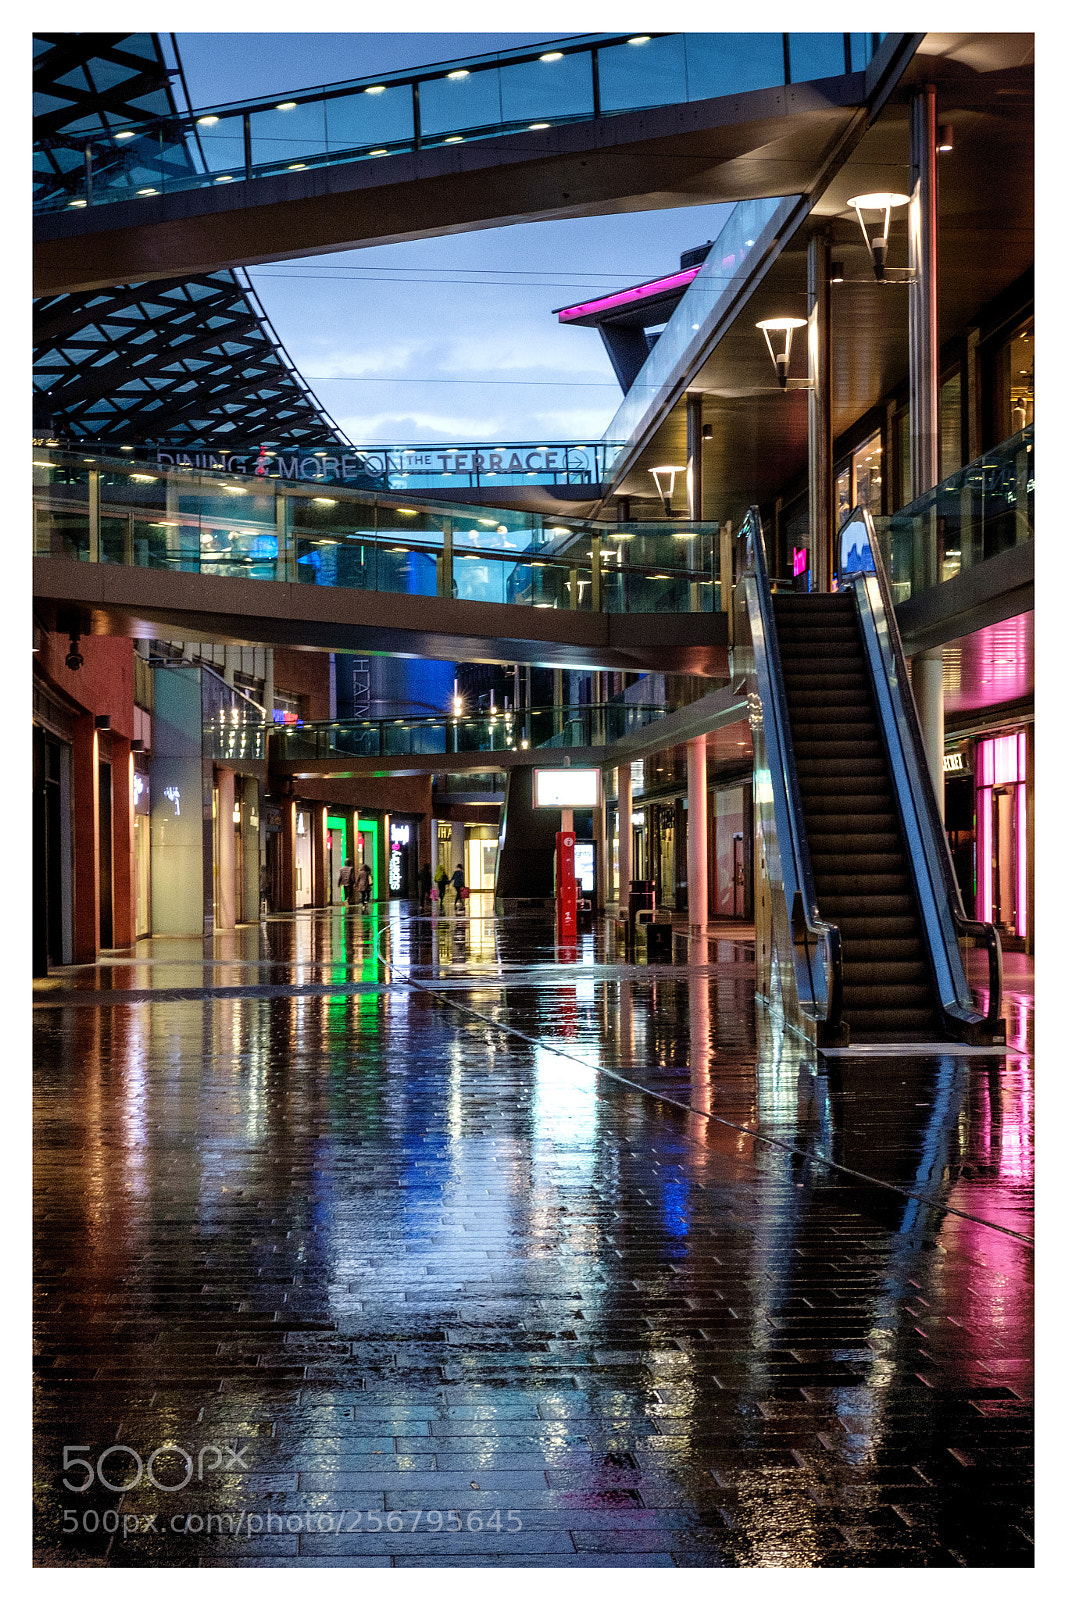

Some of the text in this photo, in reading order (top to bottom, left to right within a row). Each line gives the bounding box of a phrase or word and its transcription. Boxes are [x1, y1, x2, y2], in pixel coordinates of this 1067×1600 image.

[277, 456, 358, 479] MORE
[366, 455, 403, 477] ON
[406, 455, 432, 465] THE
[437, 452, 559, 474] TERRACE
